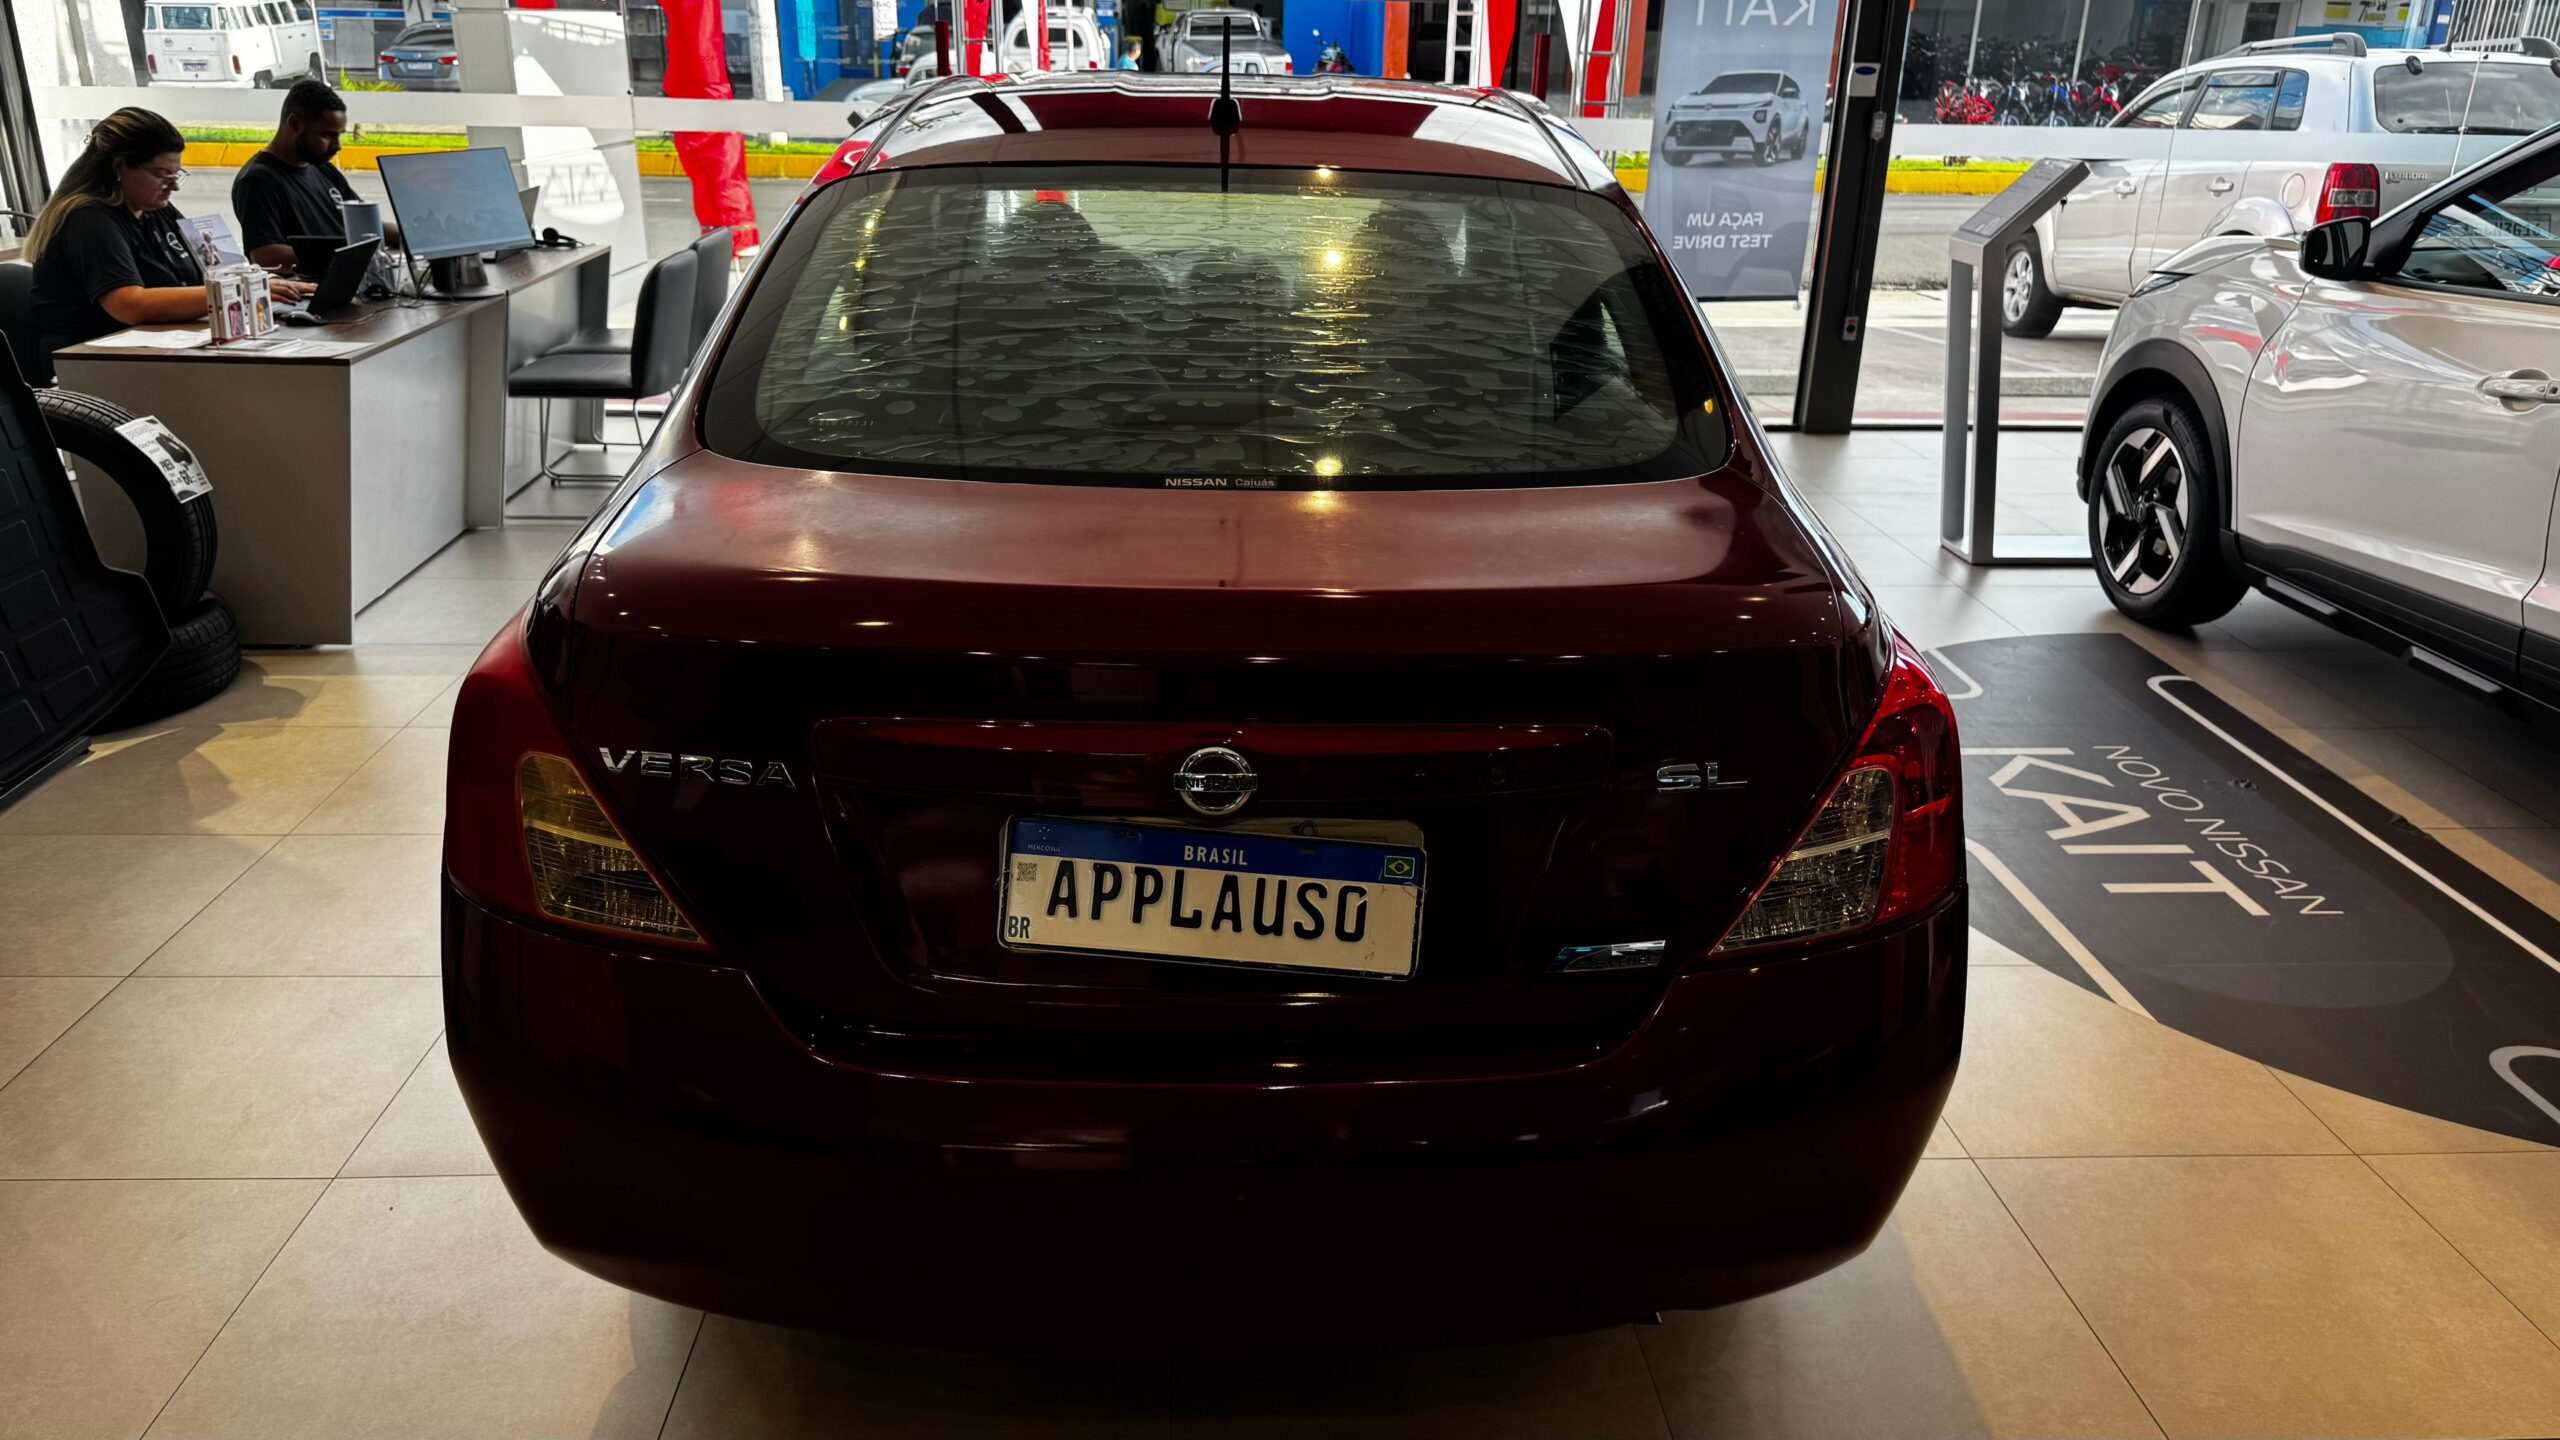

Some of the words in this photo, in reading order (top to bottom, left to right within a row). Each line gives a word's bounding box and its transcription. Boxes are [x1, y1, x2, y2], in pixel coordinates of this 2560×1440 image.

[1165, 478, 1228, 487] NISSAN
[1235, 477, 1275, 487] Caiuás
[598, 747, 796, 789] VERSA
[1656, 761, 1748, 795] SL
[1961, 747, 2271, 917] KAIT
[2093, 745, 2204, 811] NOVO
[2184, 818, 2344, 915] NISSAN
[1027, 843, 1061, 853] MERCOSUL
[1183, 845, 1248, 866] BRASIL
[1046, 859, 1367, 943] APPLAUSO
[1008, 916, 1030, 940] BR
